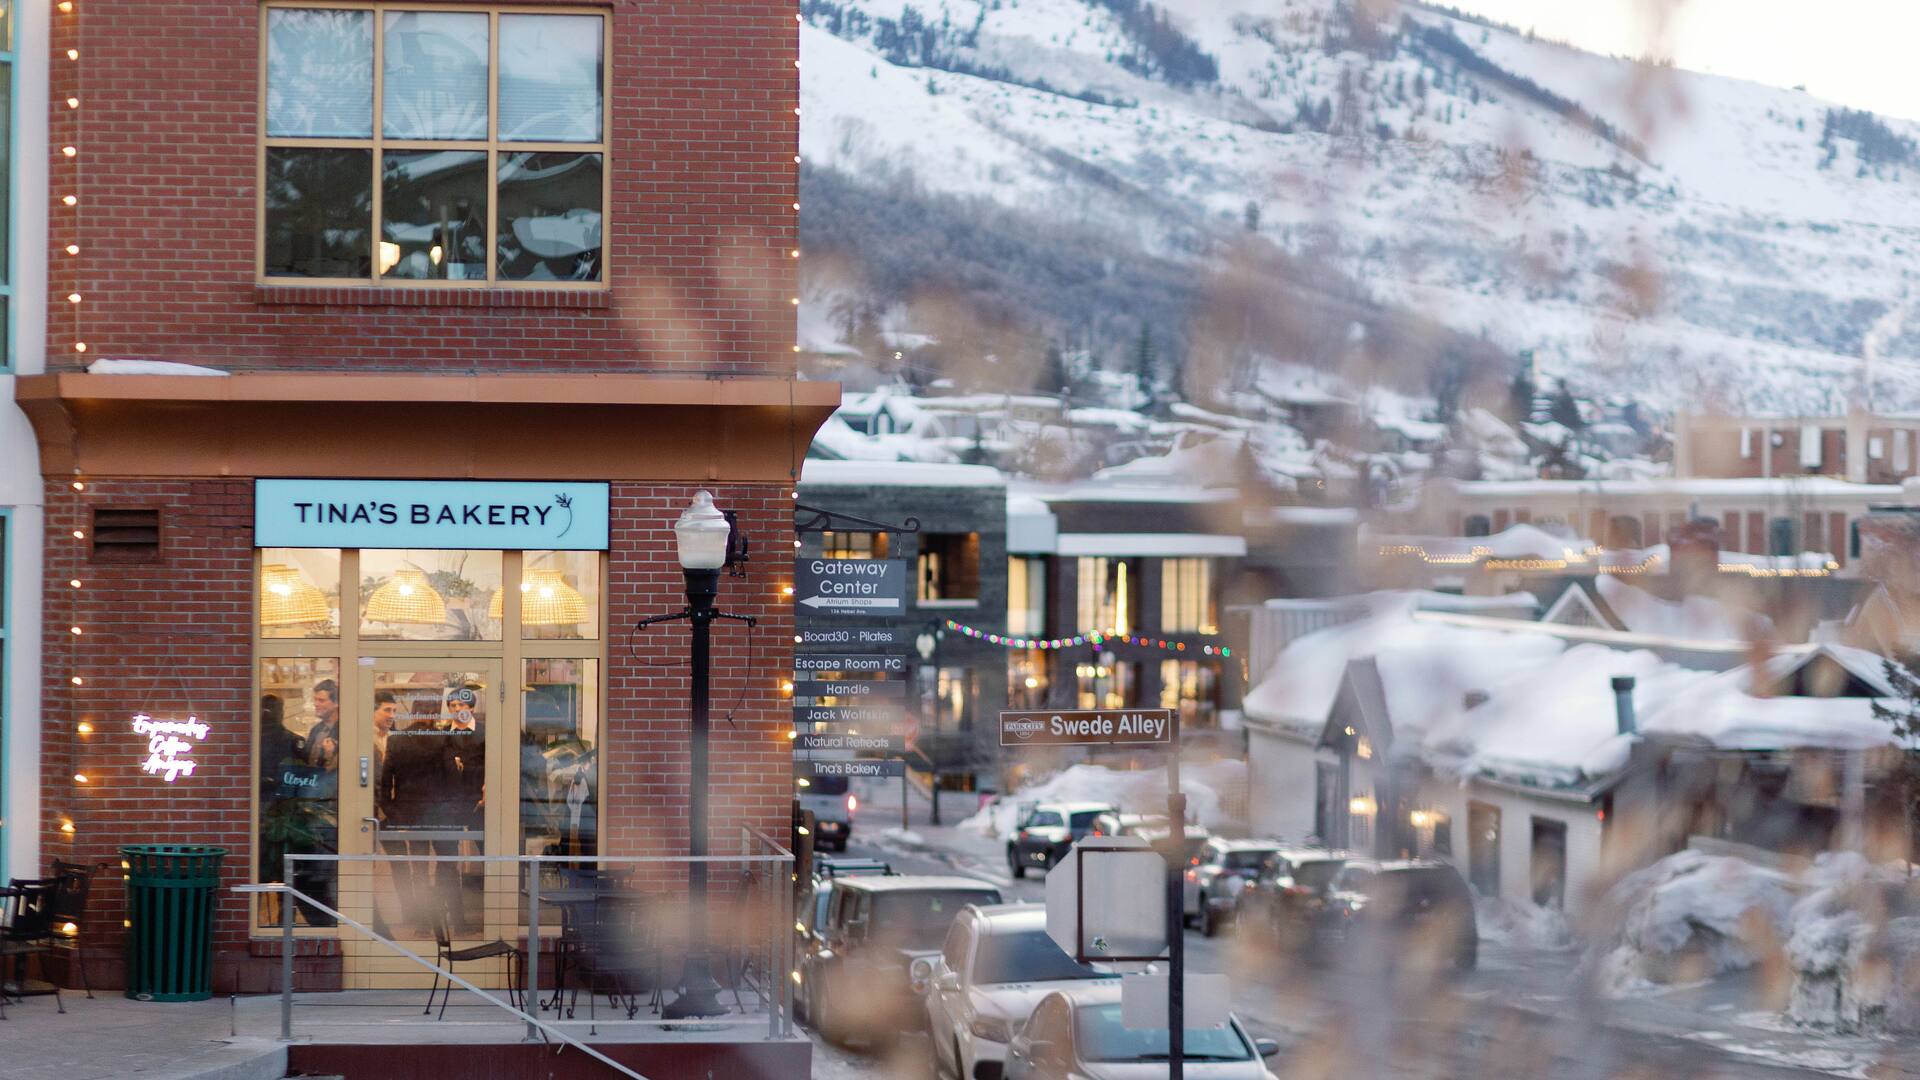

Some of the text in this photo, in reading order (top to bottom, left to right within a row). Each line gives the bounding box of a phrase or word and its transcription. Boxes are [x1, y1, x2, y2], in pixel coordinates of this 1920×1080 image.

[294, 501, 552, 526] TINA'S BAKERY
[811, 560, 888, 577] Gateway
[820, 580, 878, 594] Center
[851, 598, 872, 606] Shops
[804, 631, 849, 642] Board30
[859, 631, 893, 642] Pilates
[795, 658, 901, 670] Escape Room PC
[826, 684, 870, 695] Handle
[807, 709, 889, 720] Jack Wolfskin
[1050, 714, 1165, 738] Swede Alley
[804, 736, 889, 748] Natural Retreats
[814, 763, 880, 775] Tina's Bakery
[283, 771, 319, 787] Closed
